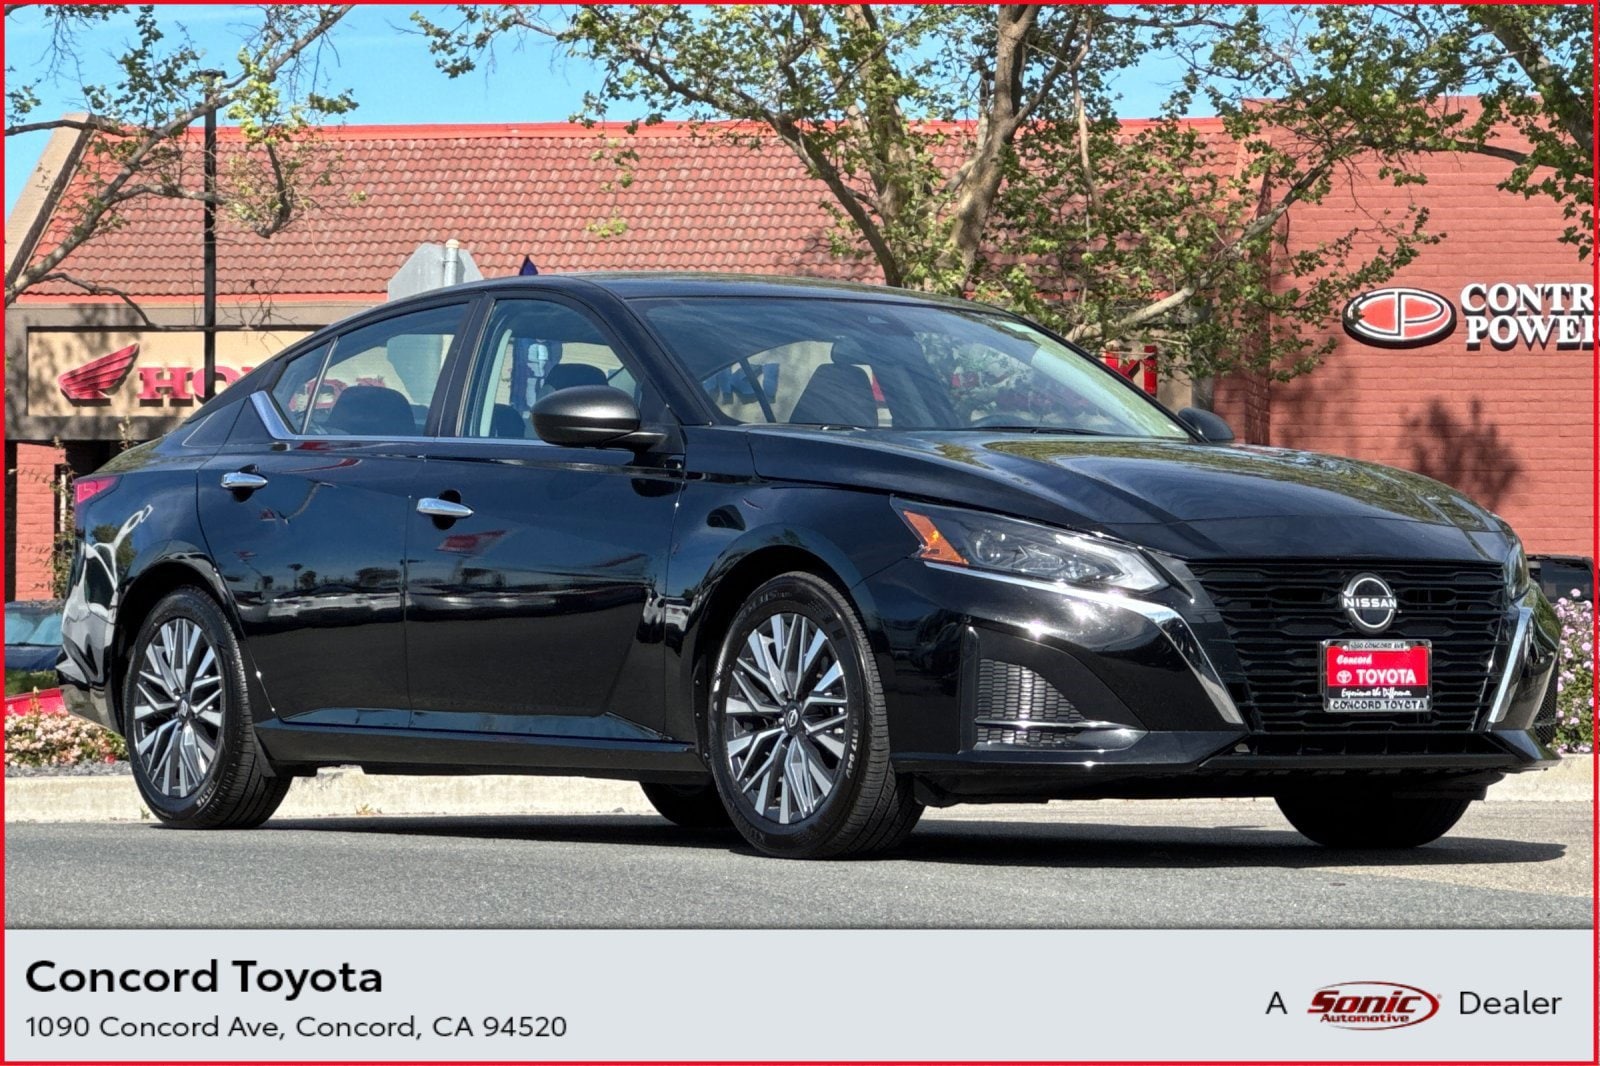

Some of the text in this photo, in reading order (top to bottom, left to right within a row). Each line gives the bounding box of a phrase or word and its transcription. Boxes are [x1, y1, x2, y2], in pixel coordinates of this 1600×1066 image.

[1343, 597, 1397, 608] NISSAN
[1336, 653, 1373, 666] Concord
[1355, 668, 1417, 684] TOYOTA
[1332, 699, 1425, 710] CONCORD TOYOTA
